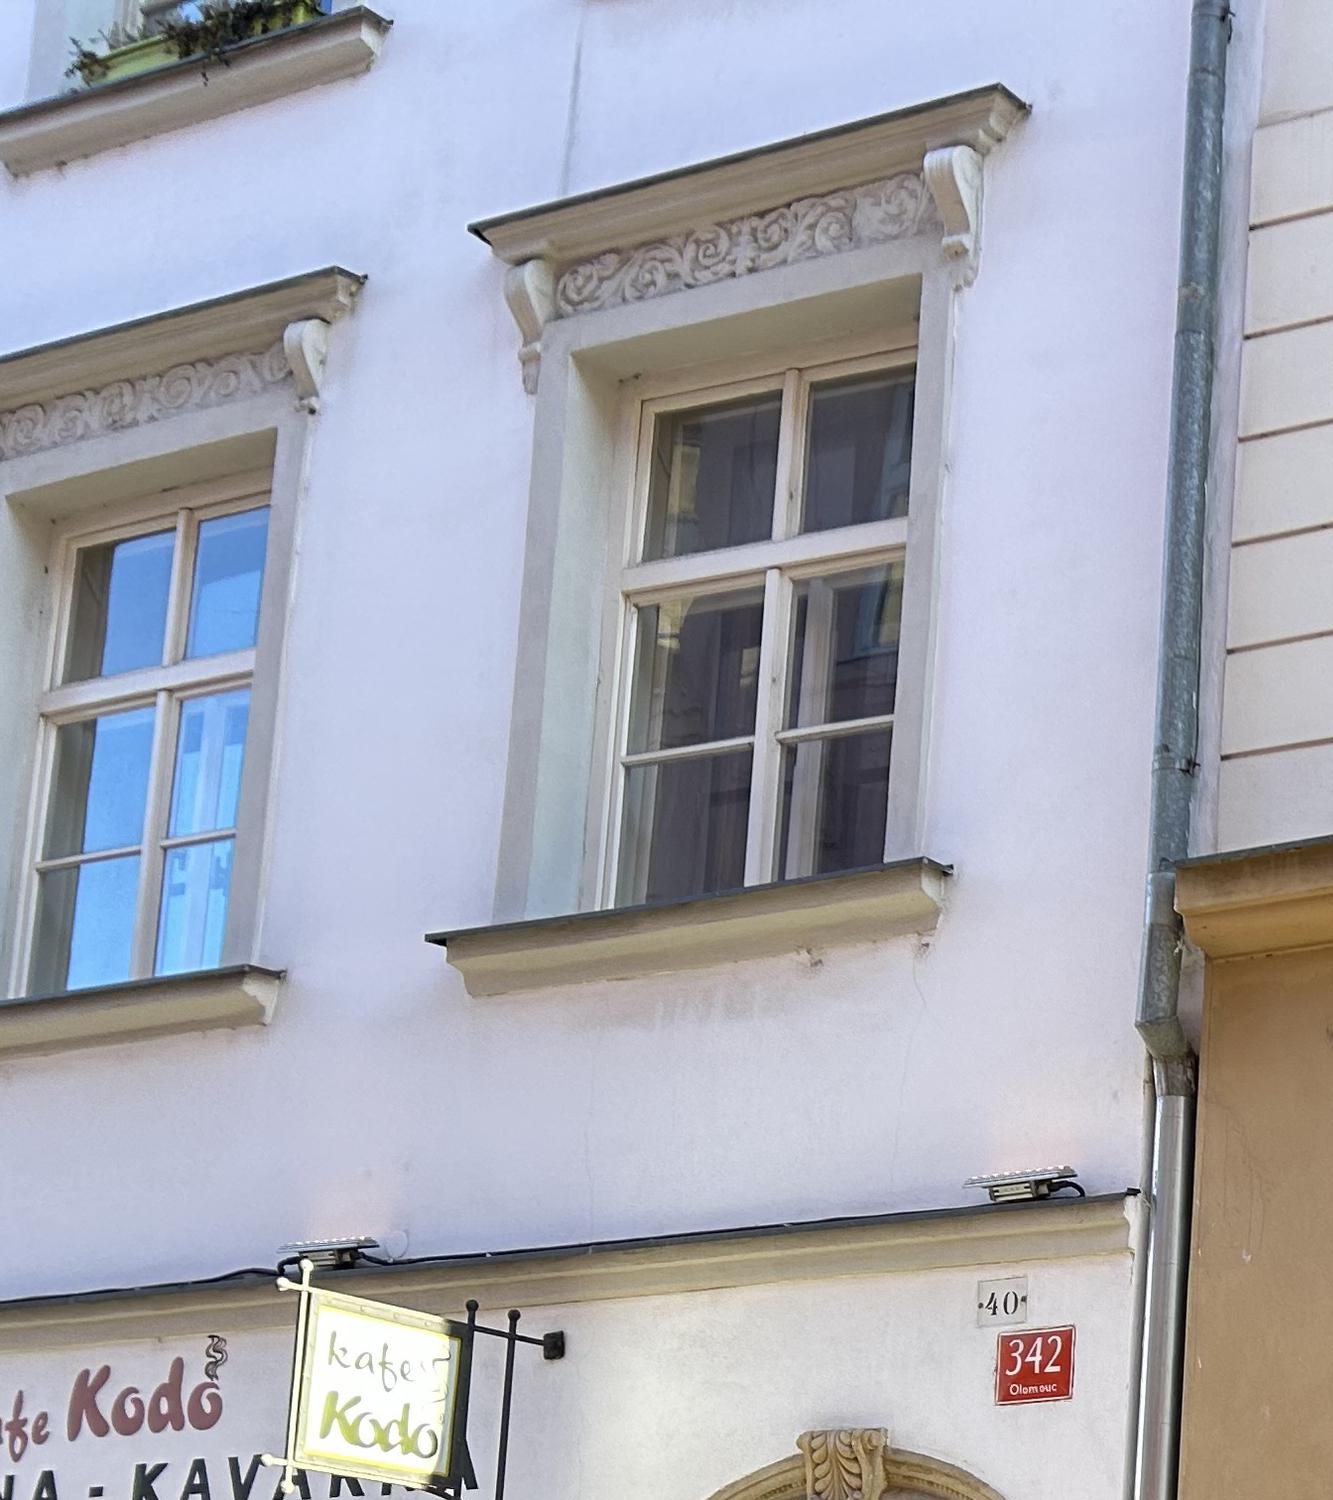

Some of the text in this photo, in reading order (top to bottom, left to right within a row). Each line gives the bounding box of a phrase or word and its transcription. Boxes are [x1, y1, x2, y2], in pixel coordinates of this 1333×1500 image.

[985, 1291, 1018, 1316] 40
[328, 1330, 416, 1392] kafe
[1005, 1335, 1063, 1376] 342
[1009, 1383, 1057, 1396] Olomouc
